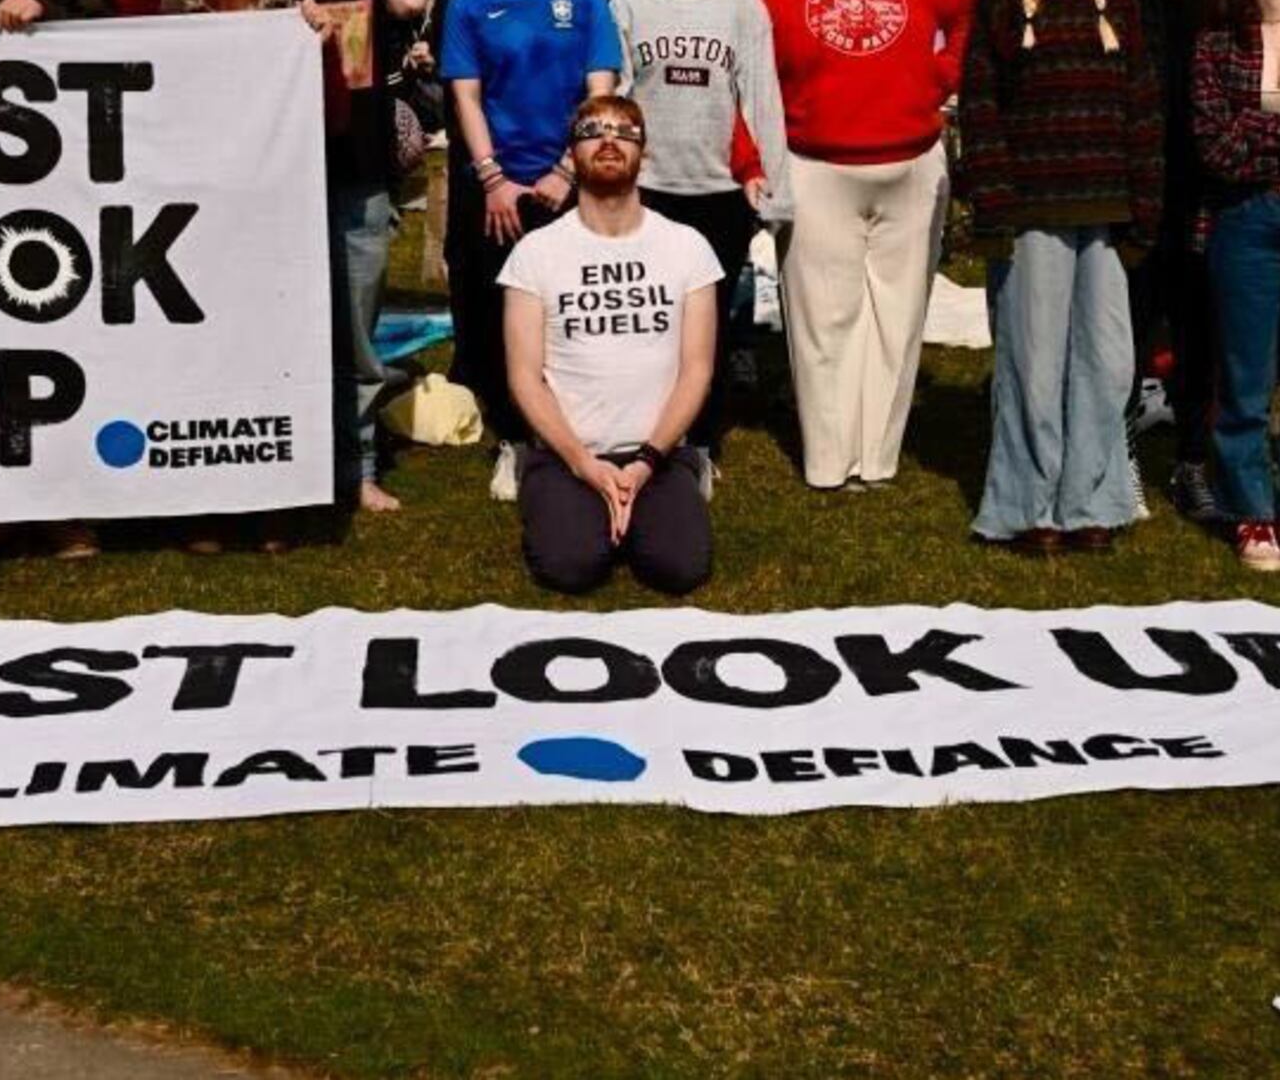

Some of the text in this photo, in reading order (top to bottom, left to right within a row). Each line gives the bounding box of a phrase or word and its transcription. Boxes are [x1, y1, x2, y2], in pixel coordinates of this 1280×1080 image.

[638, 36, 735, 72] BOSTON
[581, 261, 645, 285] END
[559, 286, 673, 314] FOSSIL
[564, 312, 668, 338] FUELS
[147, 416, 292, 442] CLIMATE
[149, 441, 292, 468] DEFIANCE
[360, 629, 1028, 709] LOOK
[683, 734, 1224, 782] DEFIANCE
